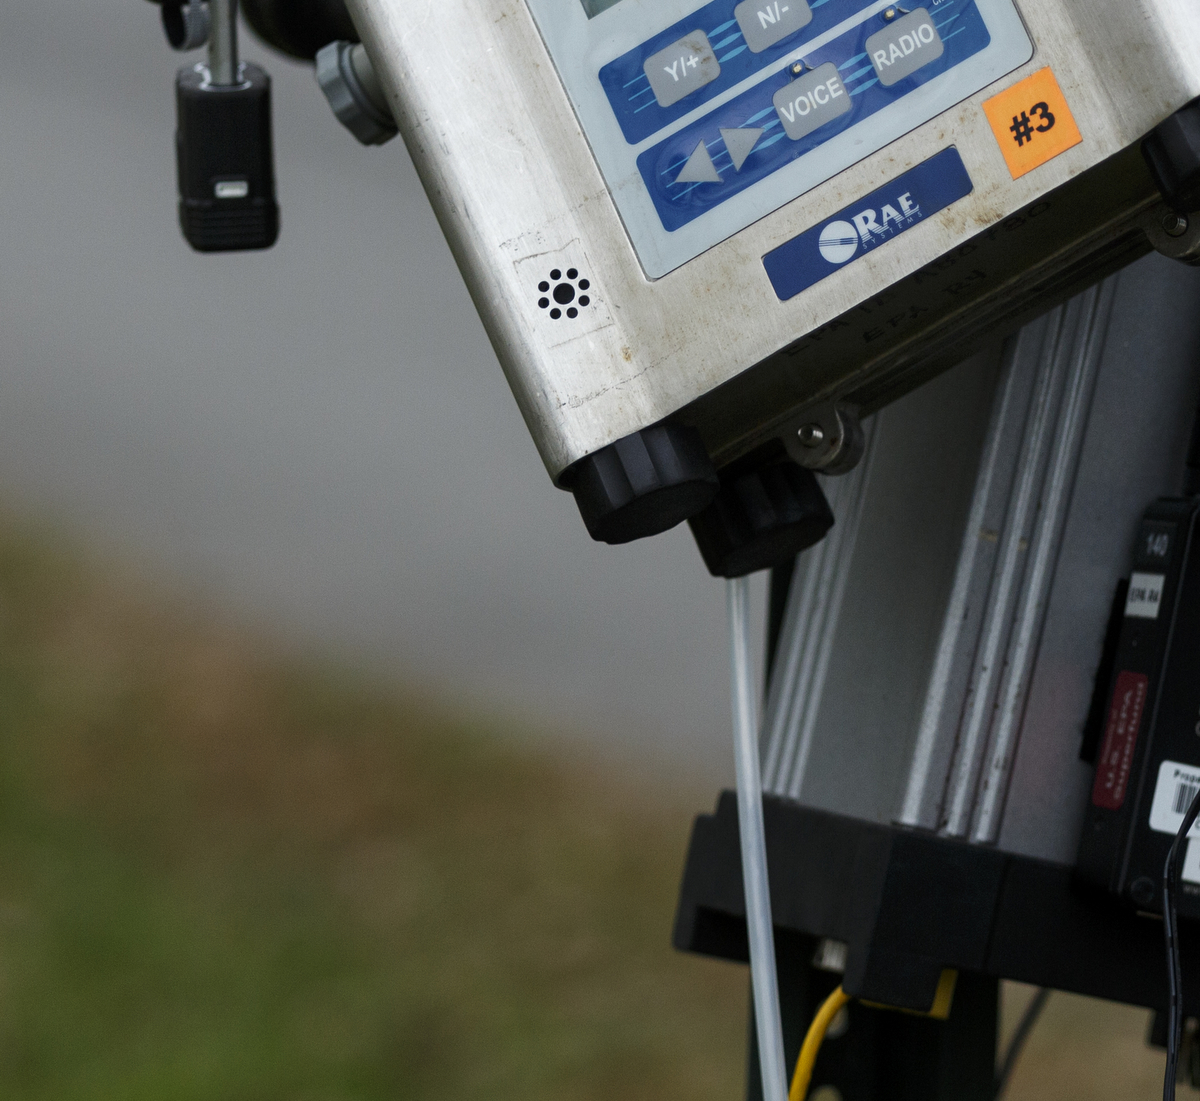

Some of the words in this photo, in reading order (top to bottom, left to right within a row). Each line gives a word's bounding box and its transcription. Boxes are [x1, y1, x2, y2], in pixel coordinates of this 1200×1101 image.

[756, 2, 790, 30] N/-
[662, 52, 700, 84] Y/+
[872, 22, 935, 72] RADIO
[780, 76, 844, 124] VOICE
[1008, 100, 1056, 148] #3
[851, 191, 920, 244] RAE
[861, 211, 924, 250] SYSTEMS
